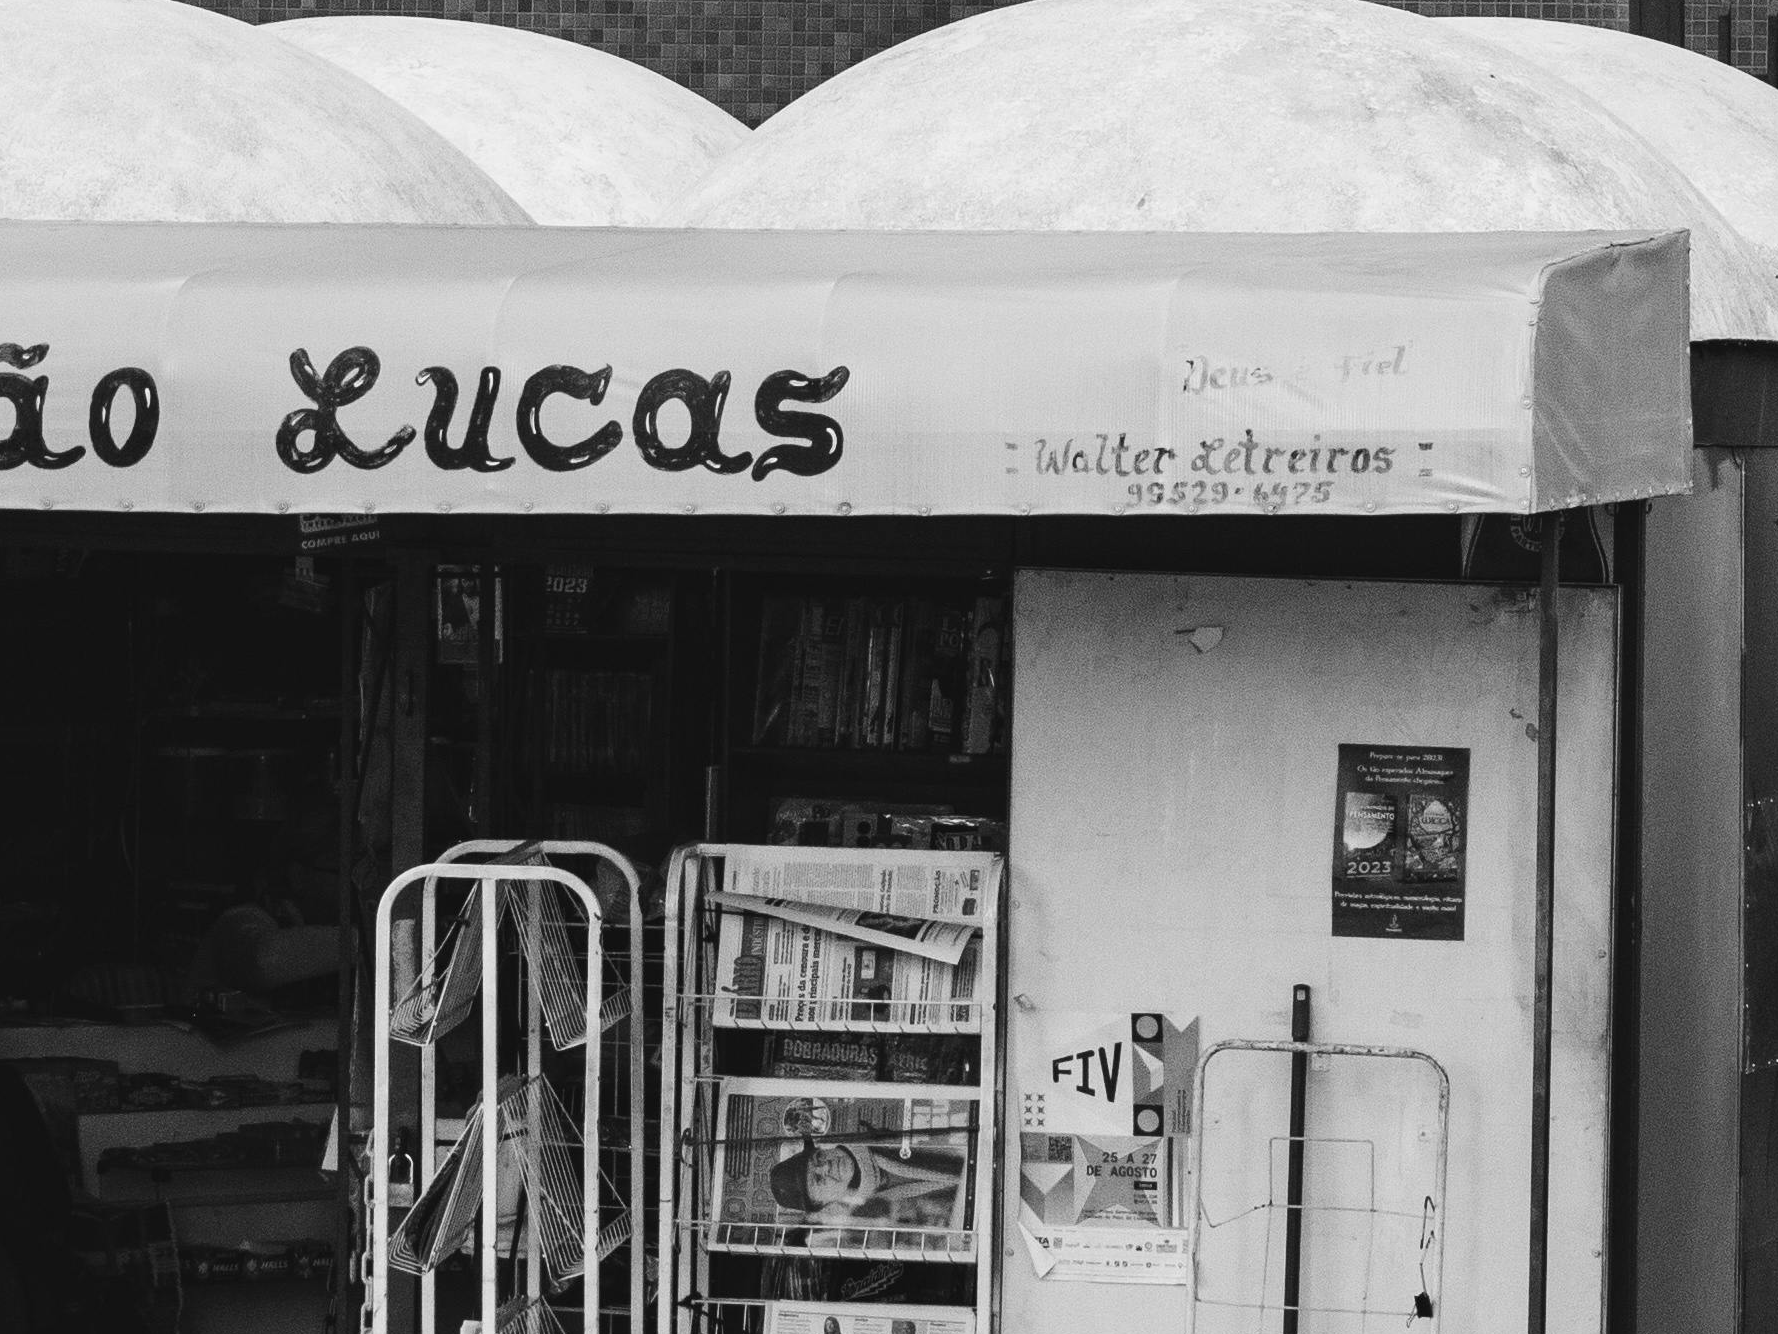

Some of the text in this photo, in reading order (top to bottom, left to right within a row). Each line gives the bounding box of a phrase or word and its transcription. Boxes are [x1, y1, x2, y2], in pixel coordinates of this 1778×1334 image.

[276, 348, 849, 481] Lucas
[1190, 429, 1396, 476] Letreiros
[351, 530, 381, 542] AQUI
[1346, 861, 1392, 875] 2023
[1102, 1151, 1157, 1164] 25 A 27
[1086, 1165, 1158, 1178] DE AGOSTO
